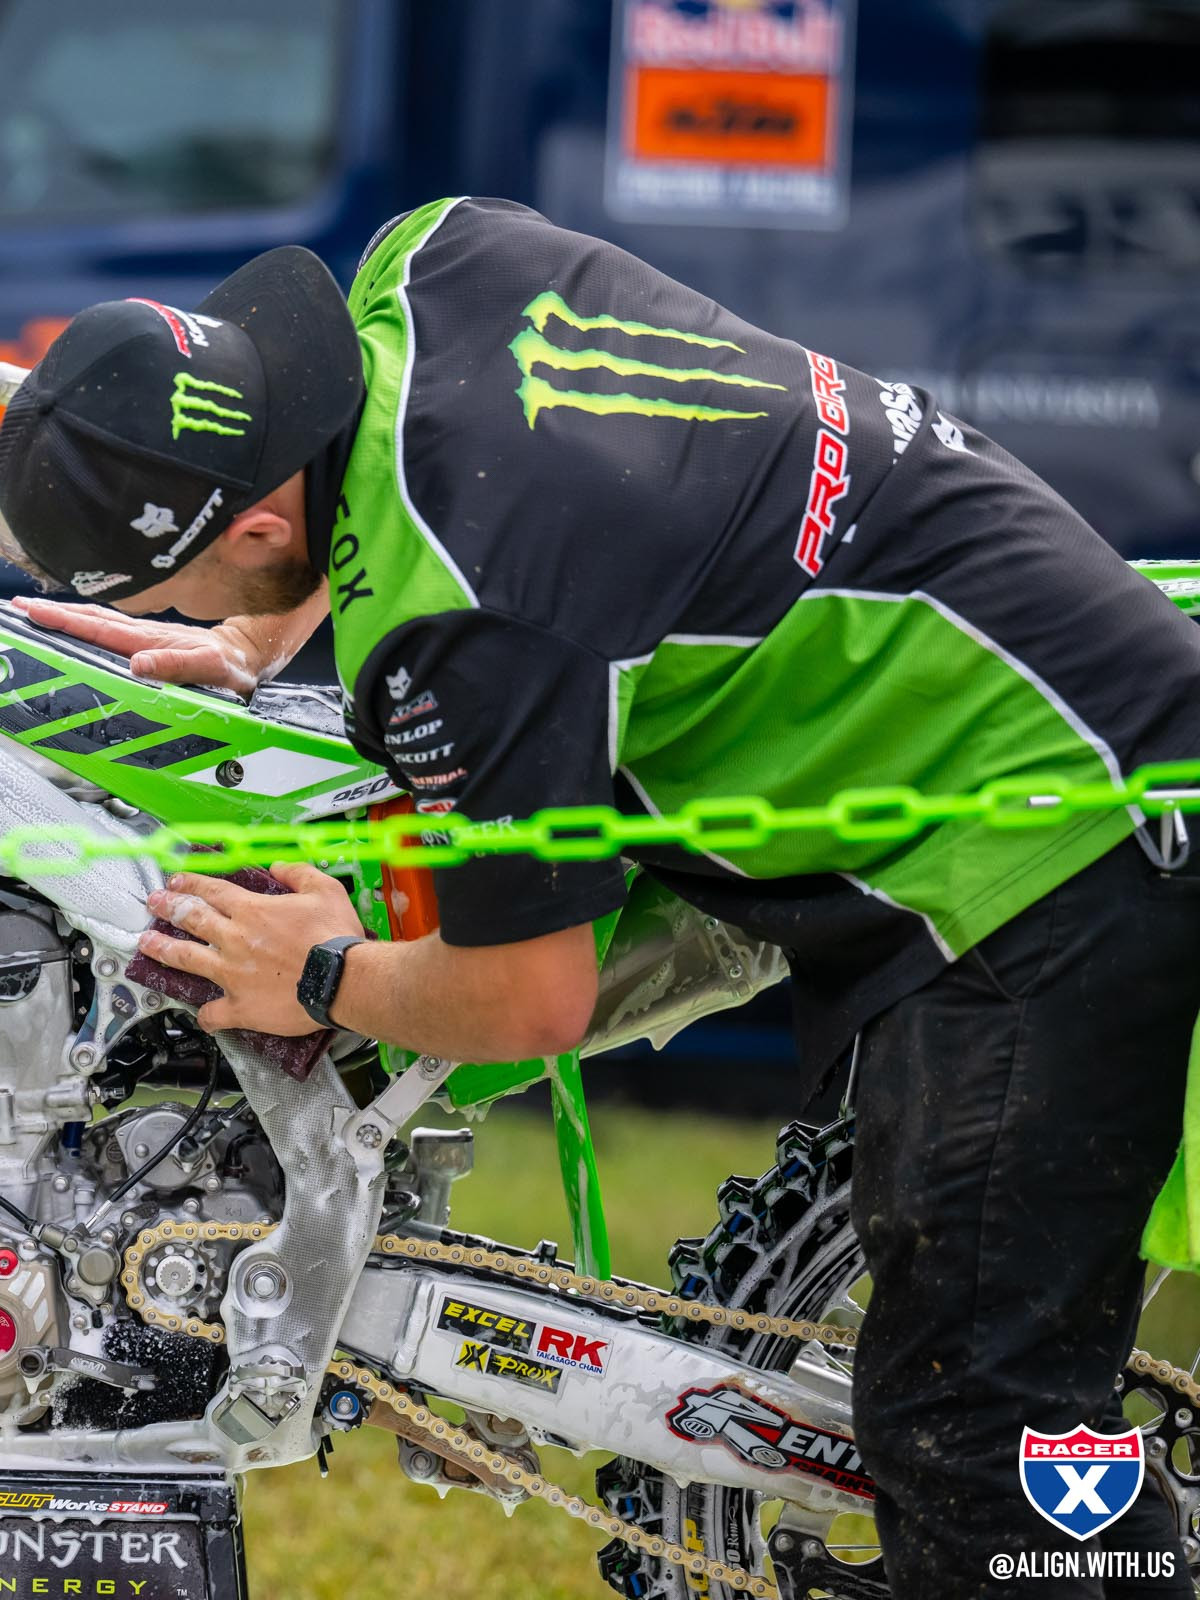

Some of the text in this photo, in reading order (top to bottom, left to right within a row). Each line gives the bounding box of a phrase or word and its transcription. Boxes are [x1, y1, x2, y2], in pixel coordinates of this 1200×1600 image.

[794, 429, 850, 577] PRO
[443, 1301, 530, 1339] EXCEL
[535, 1349, 603, 1375] TAKASAGO CHAIN
[536, 1325, 609, 1368] RK
[49, 1498, 108, 1512] Works
[109, 1502, 166, 1513] STAND
